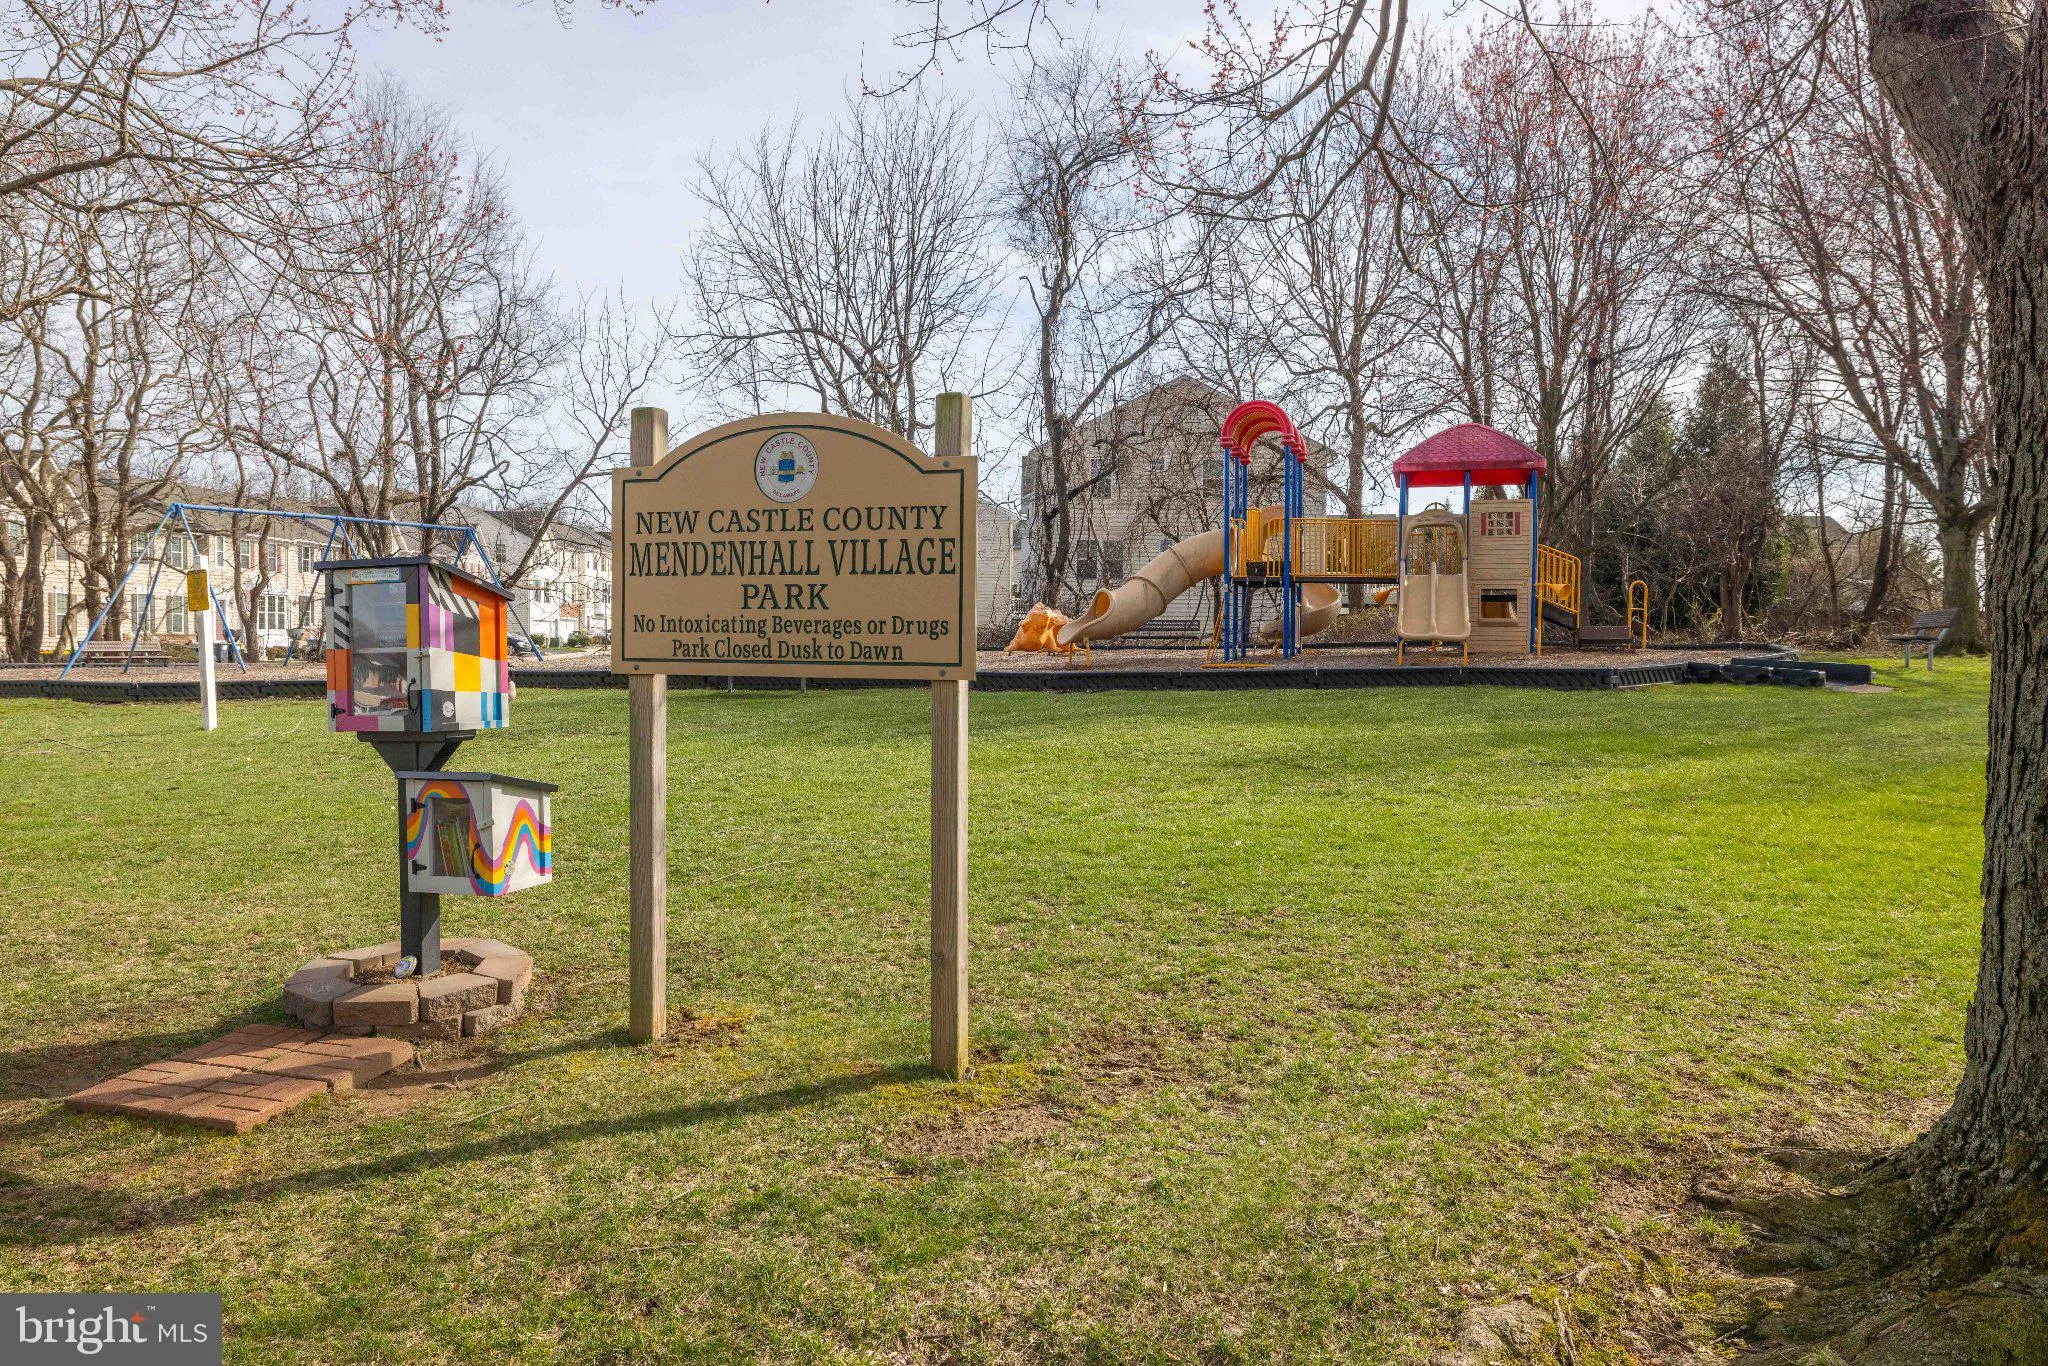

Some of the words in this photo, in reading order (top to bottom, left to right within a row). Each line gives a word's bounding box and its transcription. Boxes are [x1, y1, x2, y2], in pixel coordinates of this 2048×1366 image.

[759, 457, 767, 476] NEW
[766, 437, 795, 454] CASTLE
[798, 441, 815, 474] COUNTY
[636, 511, 700, 534] NEW
[708, 508, 814, 533] CASTLE
[823, 505, 947, 530] COUNTY
[629, 540, 820, 576] MENDENHALL
[828, 538, 956, 575] VILLAGE
[741, 584, 830, 609] PARK
[633, 614, 655, 633] No
[660, 615, 766, 638] Intoxicating
[772, 615, 861, 638] Beverages
[867, 619, 886, 634] or
[892, 616, 948, 640] Drugs
[672, 637, 710, 657] Park
[714, 639, 772, 658] Closed
[778, 640, 822, 659] Dusk
[827, 642, 845, 659] to
[850, 641, 903, 660] Dawn
